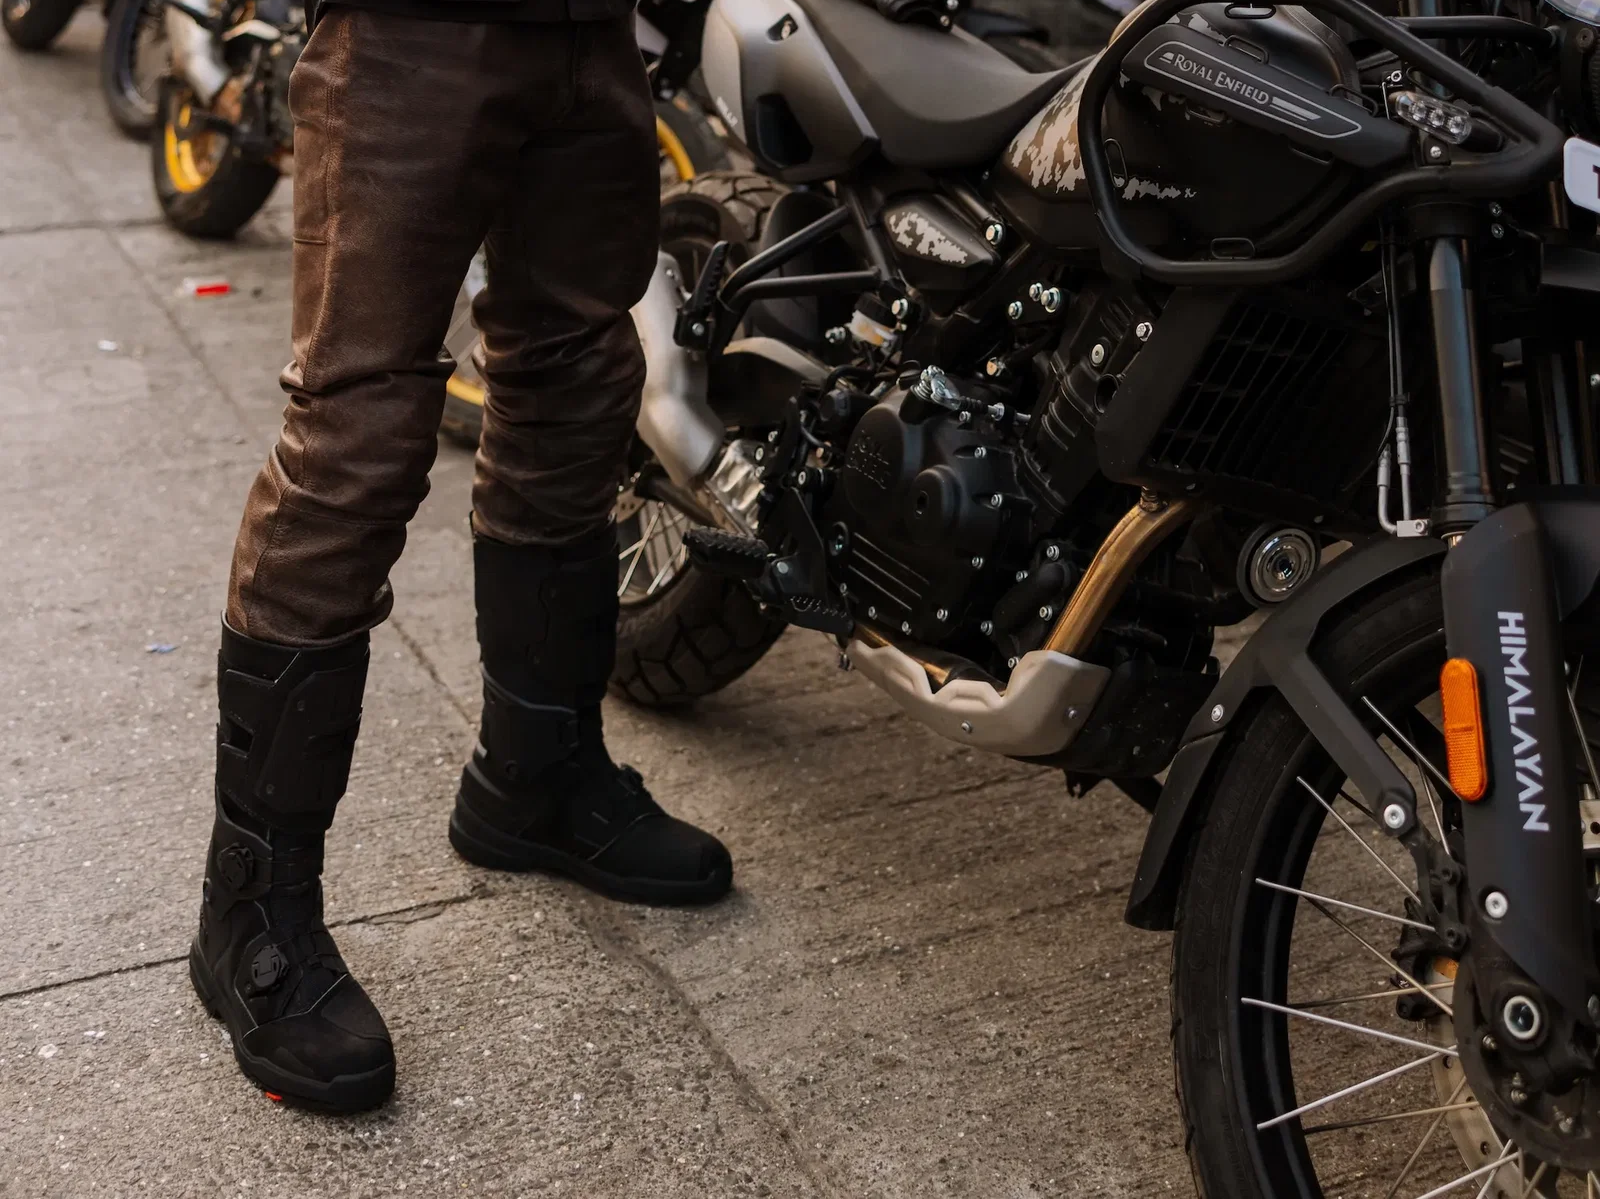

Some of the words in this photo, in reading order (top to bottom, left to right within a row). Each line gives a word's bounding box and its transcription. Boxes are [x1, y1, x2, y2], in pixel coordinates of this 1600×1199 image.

[1173, 53, 1213, 82] ROYAL
[1214, 71, 1269, 104] ENFIELD
[1497, 611, 1550, 832] HIMALAYAN
